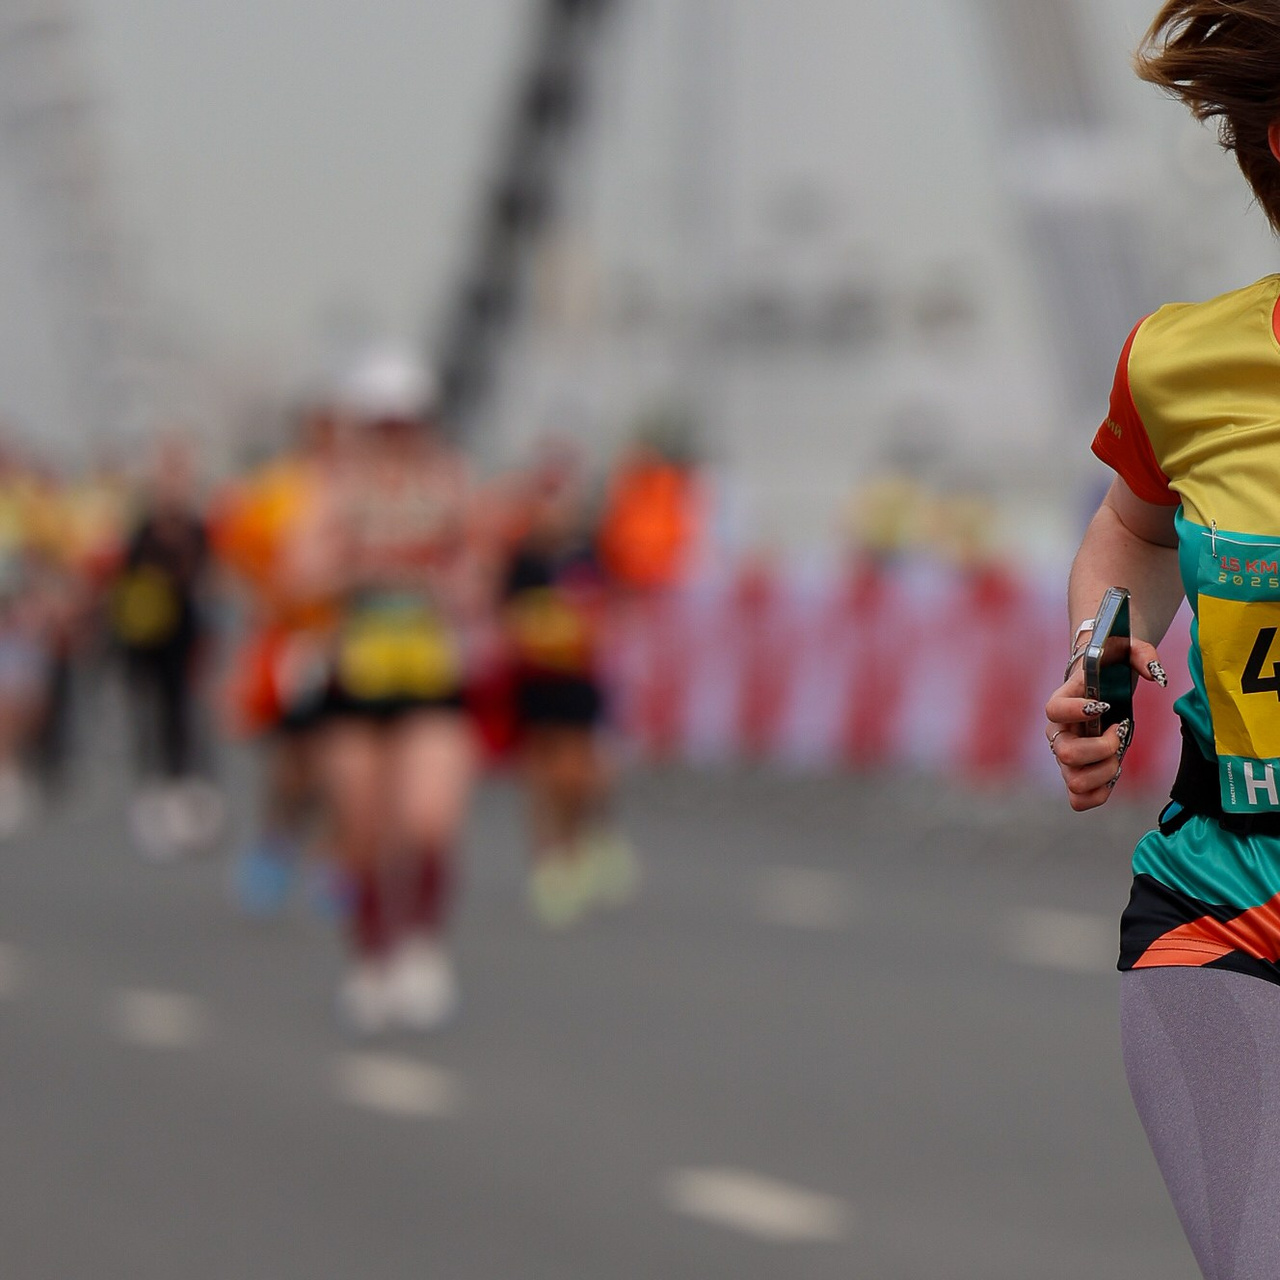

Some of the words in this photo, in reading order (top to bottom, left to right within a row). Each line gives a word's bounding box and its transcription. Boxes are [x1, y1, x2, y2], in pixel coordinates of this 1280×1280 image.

[1221, 556, 1240, 572] 15
[1246, 559, 1278, 575] КМ
[1219, 571, 1279, 588] 2025
